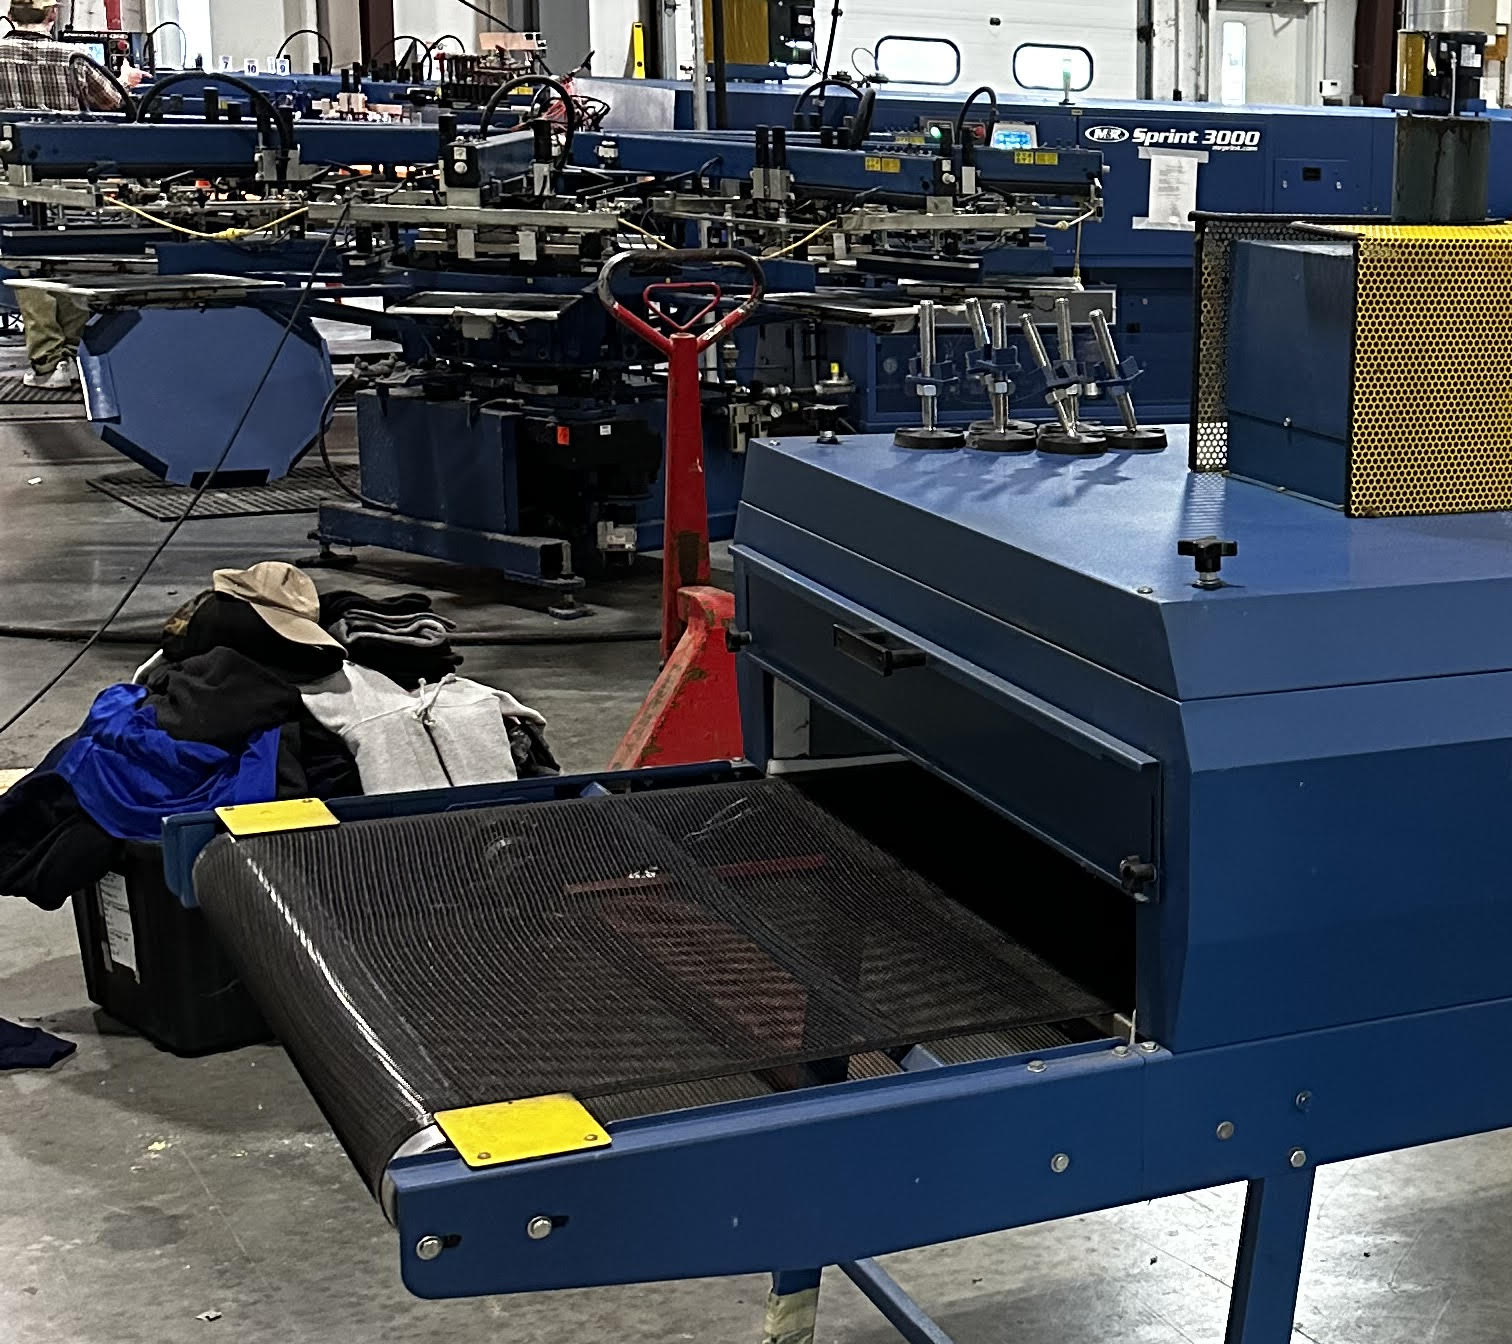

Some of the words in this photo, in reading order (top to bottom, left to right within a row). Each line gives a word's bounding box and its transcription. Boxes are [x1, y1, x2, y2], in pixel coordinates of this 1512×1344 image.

[247, 64, 257, 73] 10
[1131, 128, 1199, 146] Sprint
[1201, 129, 1261, 146] 3000
